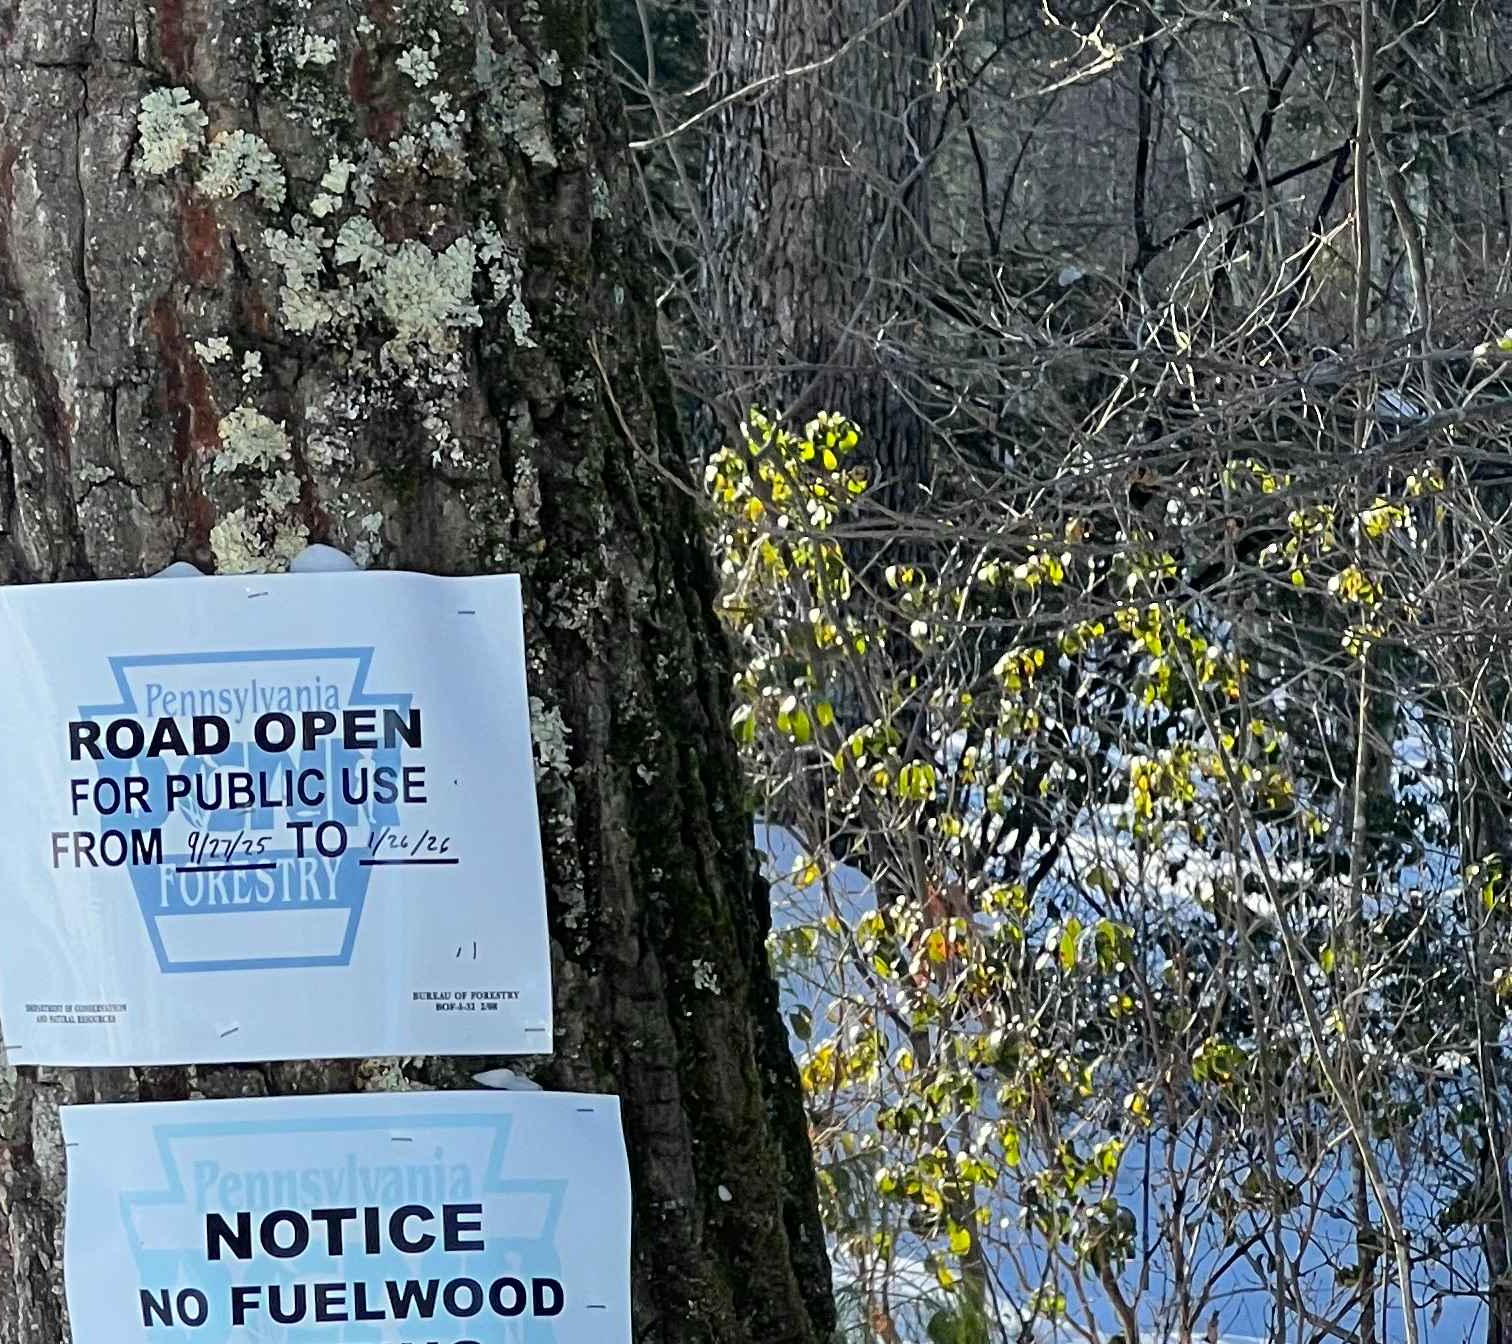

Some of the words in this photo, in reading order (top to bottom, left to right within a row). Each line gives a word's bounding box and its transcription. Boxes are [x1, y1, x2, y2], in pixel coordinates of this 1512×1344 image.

[145, 677, 341, 724] Pennsylvania
[69, 714, 230, 760] ROAD
[254, 708, 422, 753] OPEN
[71, 776, 151, 816] FOR
[166, 768, 325, 811] PUBLIC
[341, 767, 427, 805] USE
[51, 827, 163, 869] FROM
[187, 830, 272, 864] 9/27/25
[286, 820, 348, 858] TO
[367, 827, 450, 857] 1/26/26
[159, 857, 342, 907] FORESTRY
[412, 991, 451, 1000] BUREAU
[454, 991, 467, 1000] OF
[470, 991, 520, 1000] FORESTRY
[195, 1146, 472, 1211] Pennsylvania
[206, 1203, 485, 1260] NOTICE
[139, 1287, 209, 1327] NO
[231, 1277, 564, 1325] FUELWOOD
